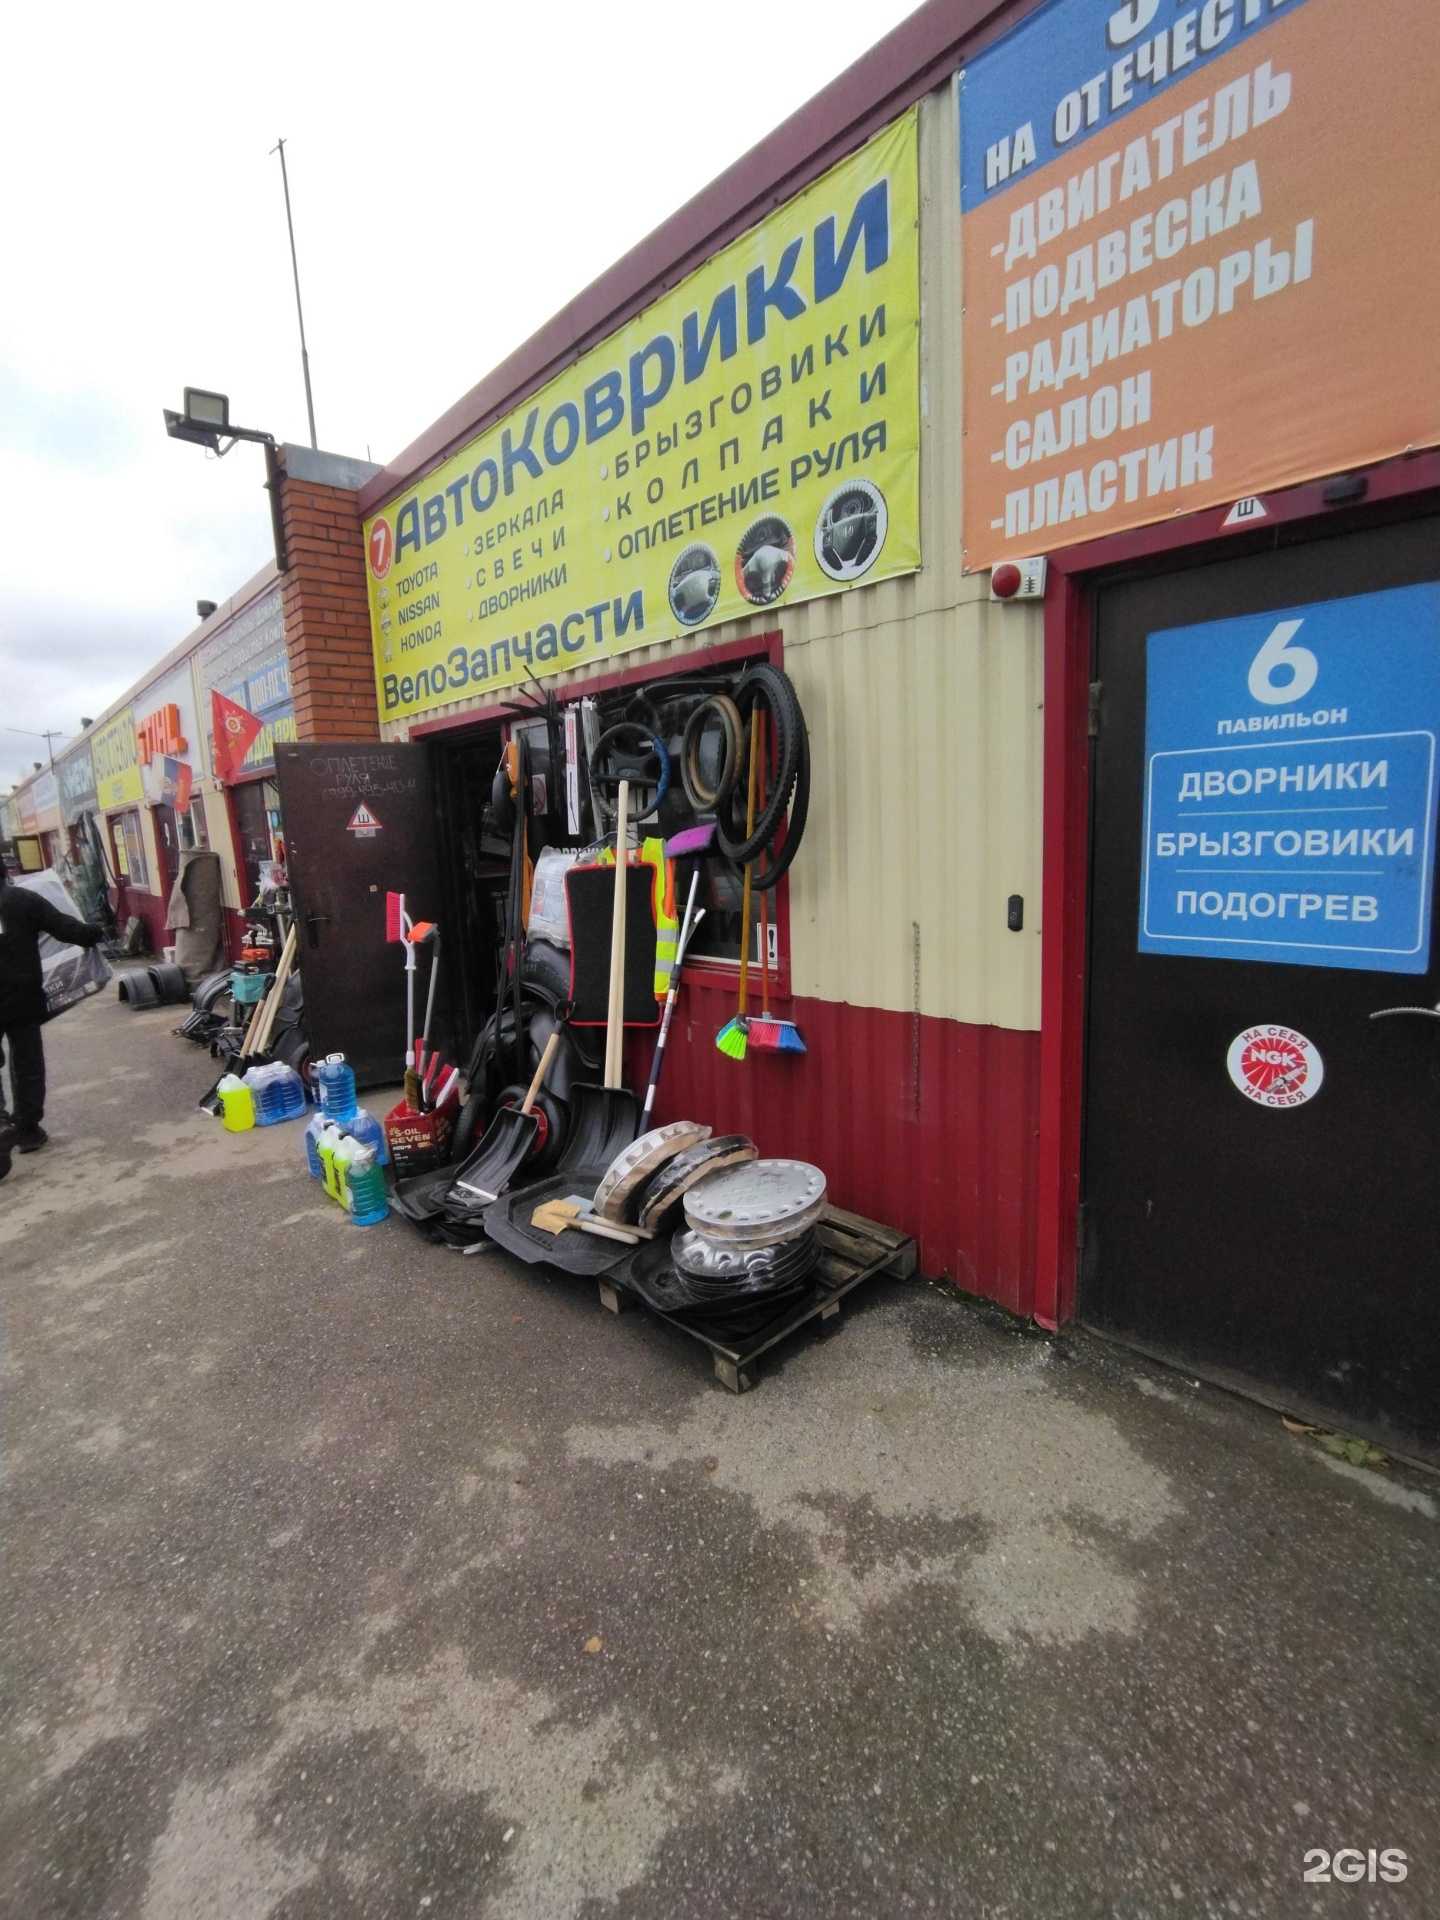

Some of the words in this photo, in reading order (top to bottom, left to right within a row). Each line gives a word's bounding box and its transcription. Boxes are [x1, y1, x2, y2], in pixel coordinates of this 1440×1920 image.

[985, 120, 1036, 189] НА
[1055, 0, 1292, 144] ОТЕЧЕС
[991, 58, 1292, 272] -ДВИГАТЕЛЬ
[991, 160, 1262, 335] -ПОДВЕСКА
[991, 217, 1314, 404] -РАДИАТОРЫ
[615, 304, 886, 479] БРЫЗГОВИКИ
[991, 371, 1151, 472] -САЛОН
[618, 467, 780, 559] ОПЛЕТЕНИЕ
[790, 420, 886, 488] РУЛЯ
[991, 424, 1215, 539] -ПЛАСТИК
[373, 528, 386, 566] 7
[474, 489, 565, 556] ЗЕРКАЛА
[396, 561, 439, 598] TOYOTA
[476, 526, 566, 587] СВЕЧИ
[398, 592, 440, 625] NISSAN
[478, 563, 567, 620] ДВОРНИКИ
[383, 589, 646, 710] ВелоЗапчасти
[401, 621, 442, 652] HONDA
[1248, 619, 1318, 705] 6
[1217, 708, 1348, 735] ПАВИЛЬОН
[1178, 760, 1388, 803] ДВОРНИКИ
[1156, 829, 1414, 858] БРЫЗГОВИКИ
[1176, 891, 1379, 923] ПОДОГРЕВ
[1242, 1029, 1262, 1042] НА
[1267, 1027, 1309, 1050] СЕБЯ
[1251, 1048, 1297, 1068] NGK
[1244, 1085, 1261, 1100] НА
[1267, 1091, 1307, 1105] СЕБЯ
